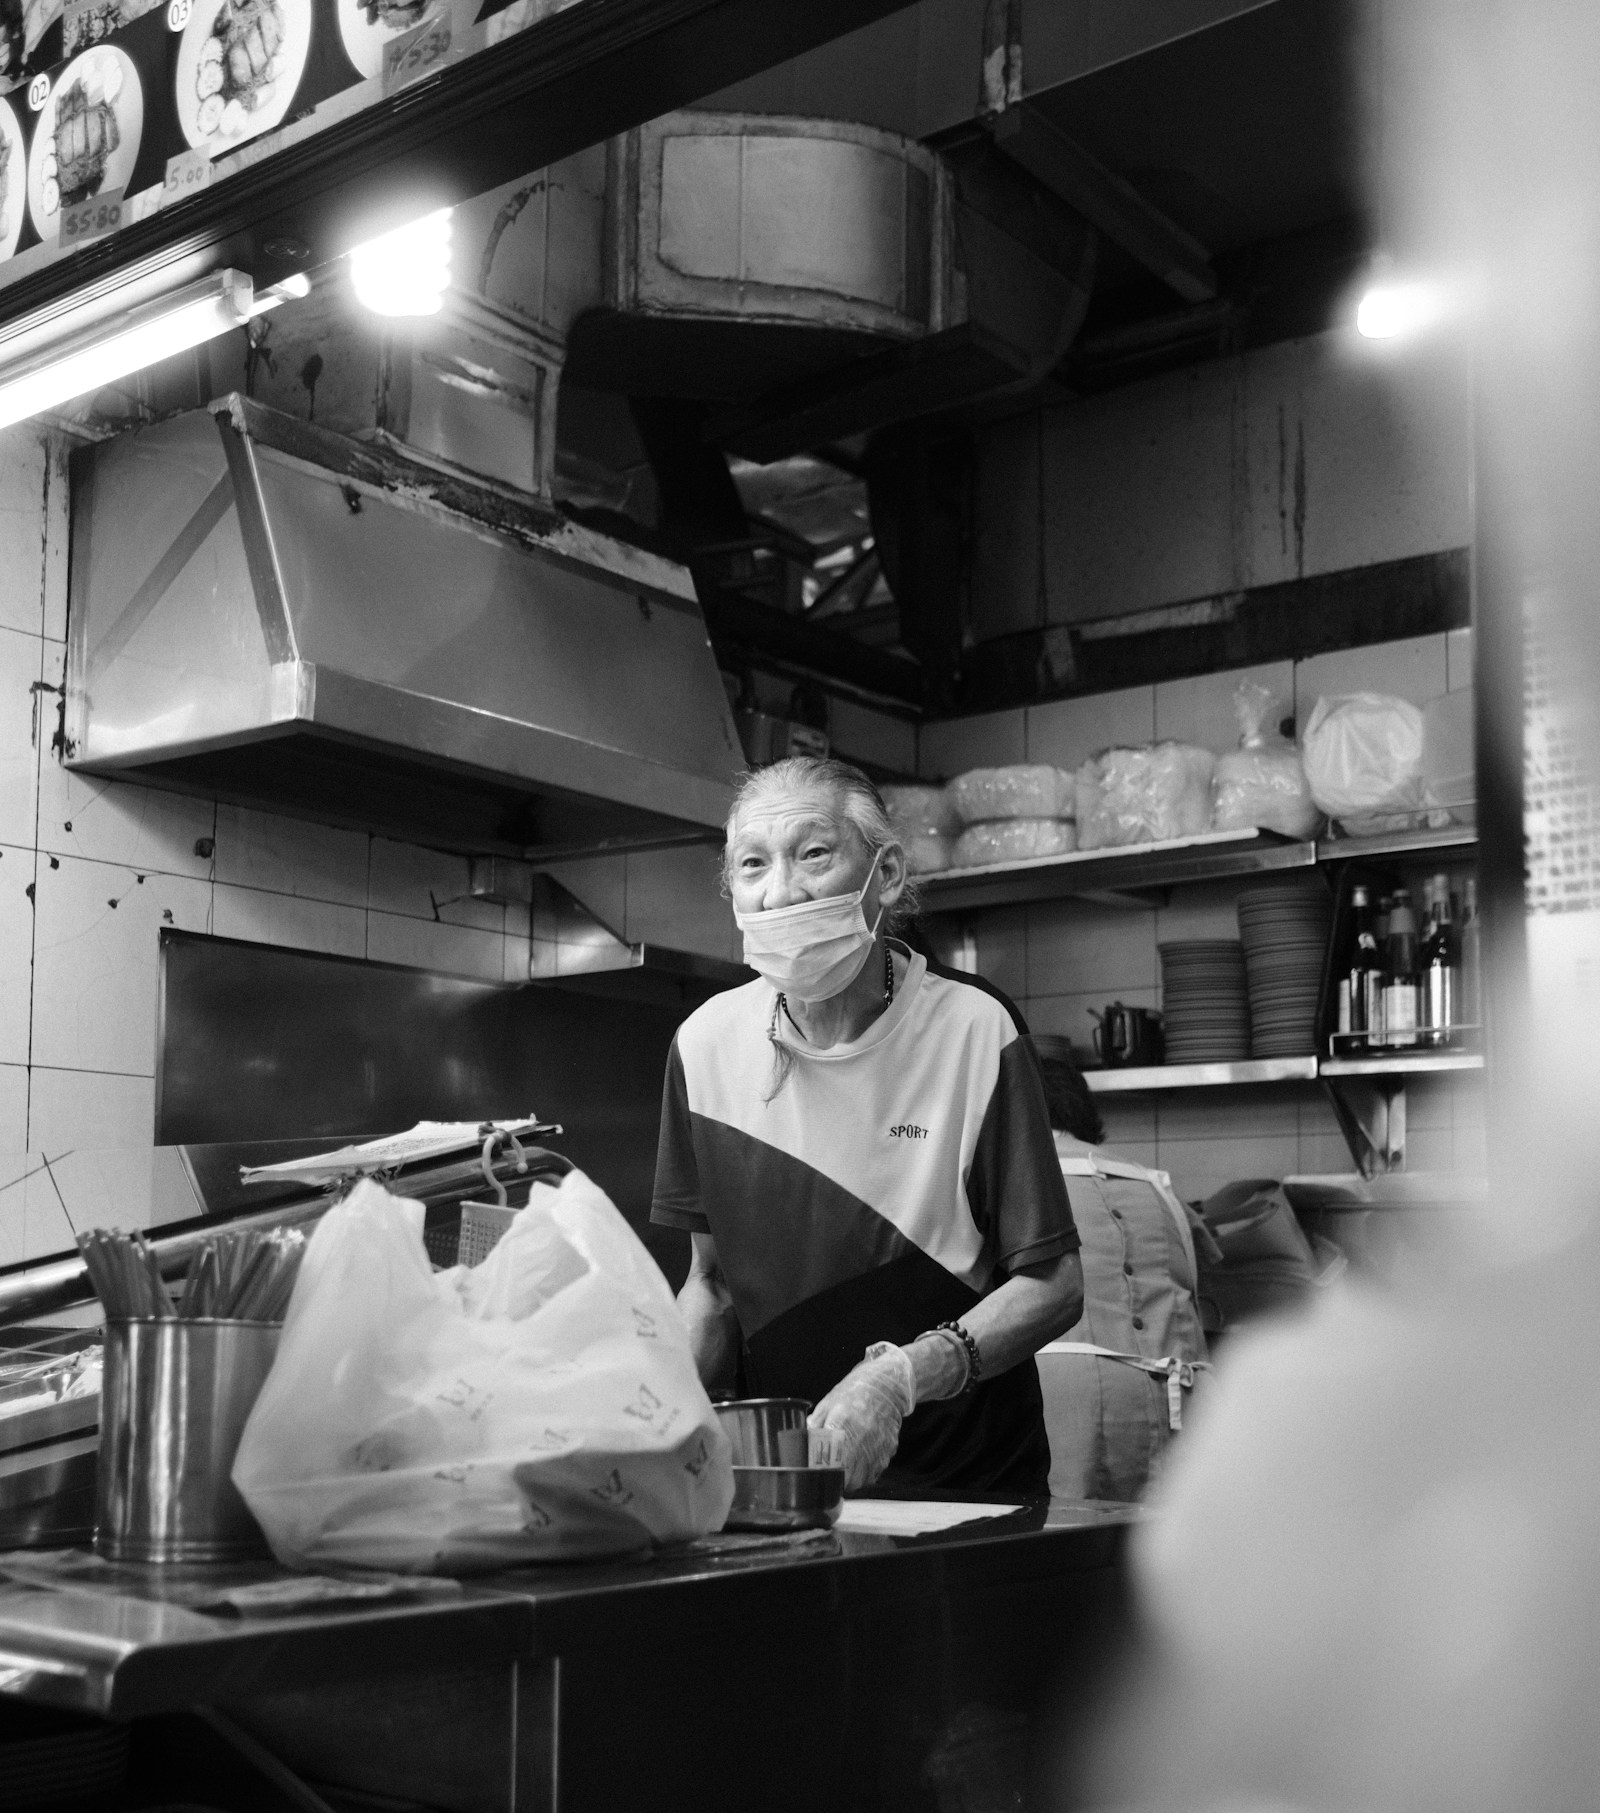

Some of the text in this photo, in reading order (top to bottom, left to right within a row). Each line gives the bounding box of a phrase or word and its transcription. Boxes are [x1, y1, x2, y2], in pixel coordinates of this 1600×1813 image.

[171, 0, 188, 25] 03
[31, 80, 47, 105] 02
[169, 166, 204, 192] 5.00
[889, 1124, 929, 1139] SPORT
